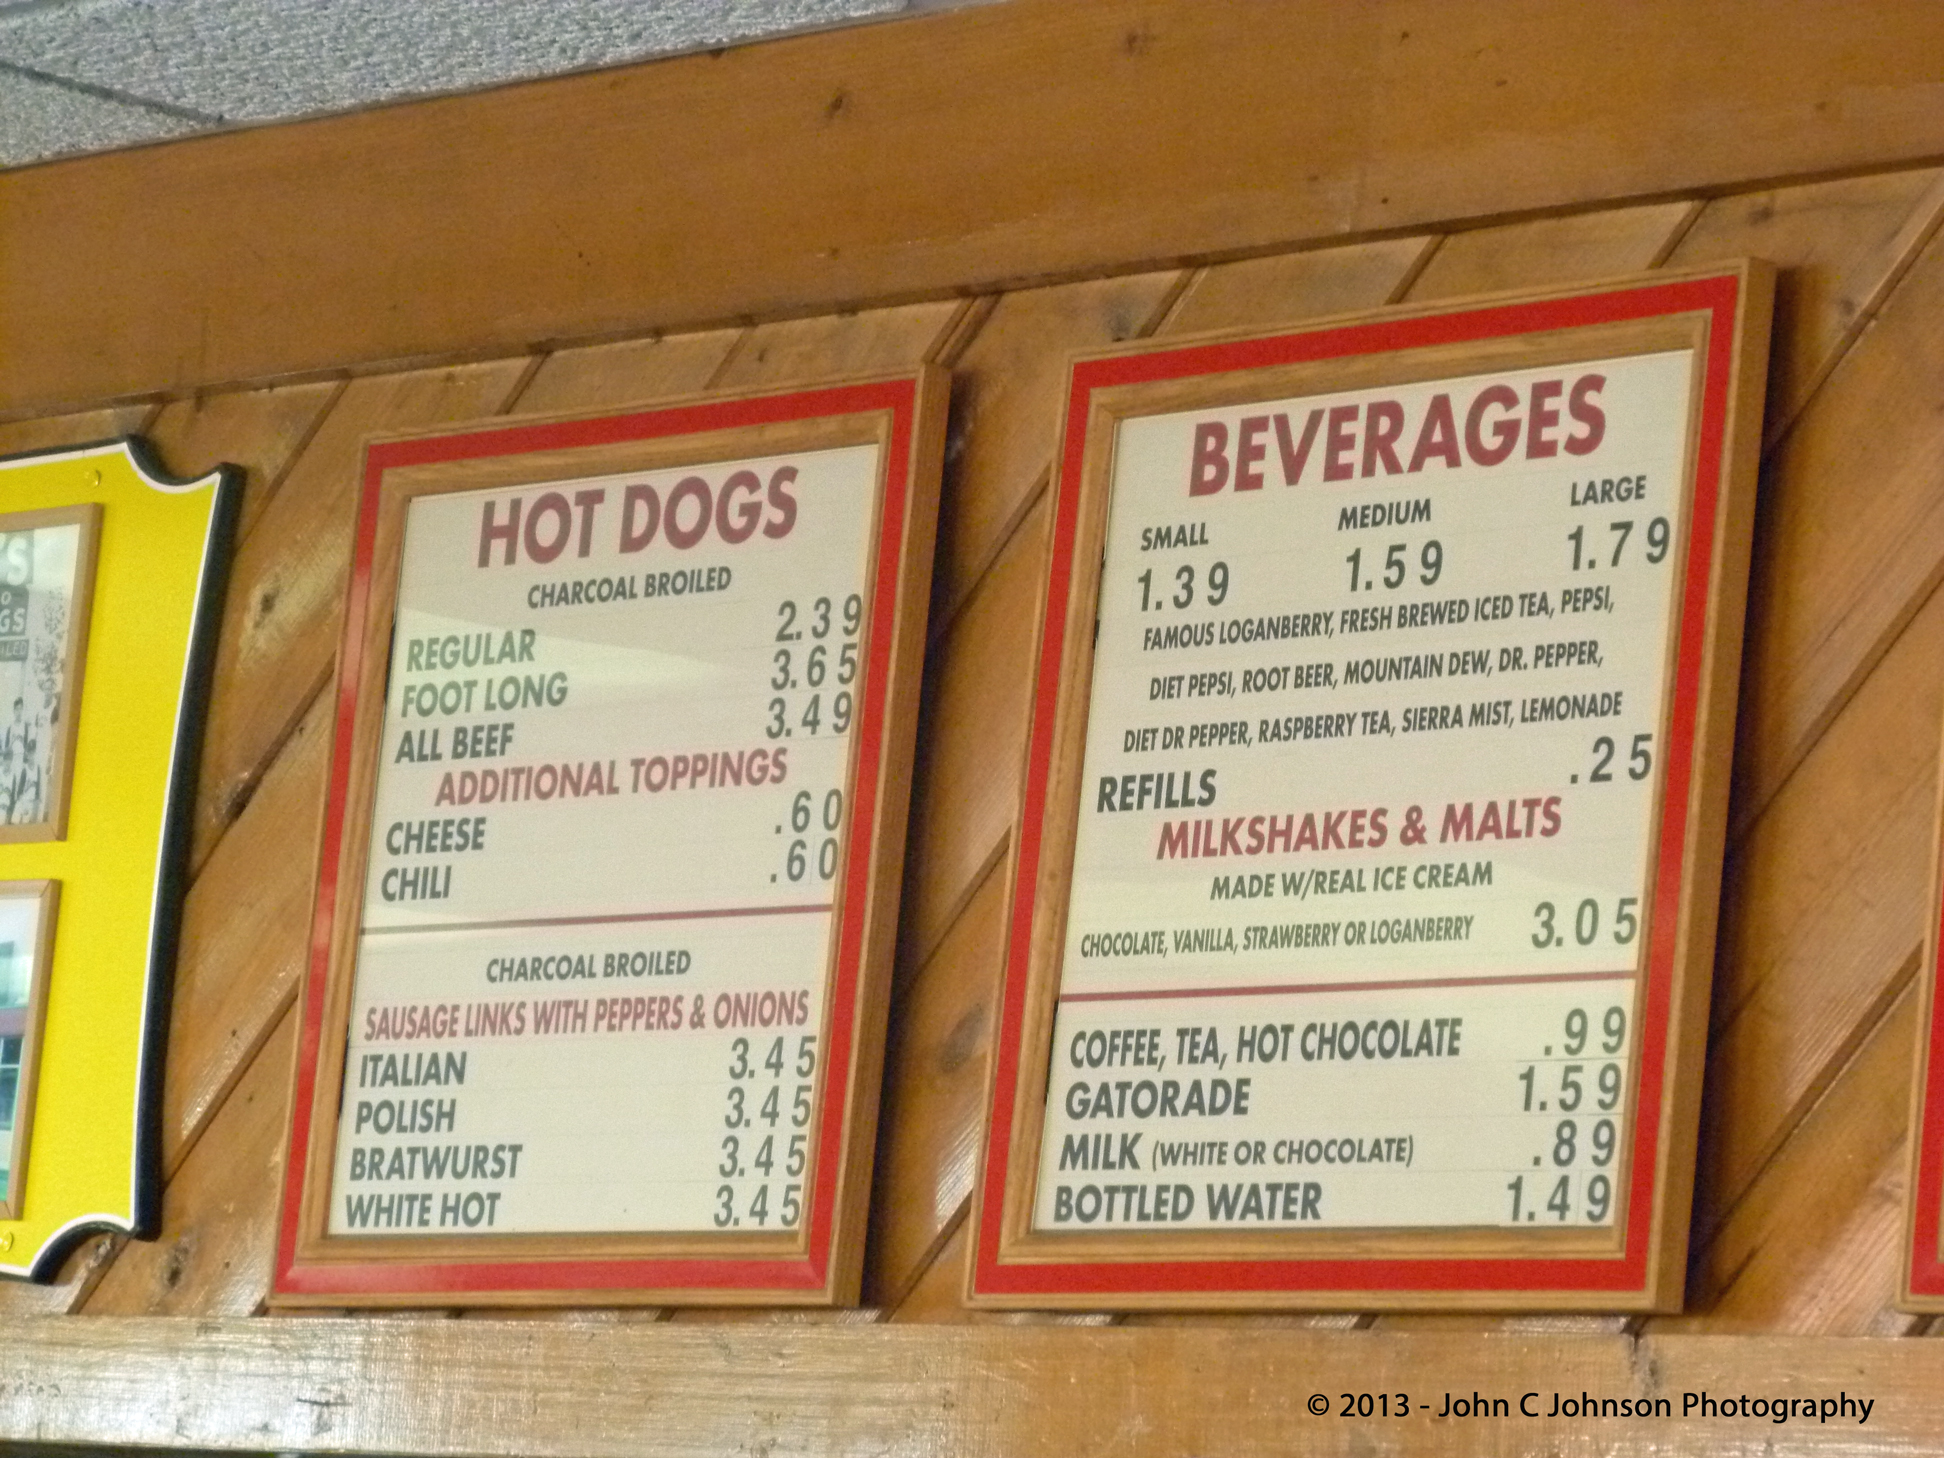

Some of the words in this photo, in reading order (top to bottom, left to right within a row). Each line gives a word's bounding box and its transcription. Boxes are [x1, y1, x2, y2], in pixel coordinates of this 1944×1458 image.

[1189, 374, 1608, 497] BEVERAGES
[478, 489, 605, 568] HOT
[619, 466, 798, 553] DOGS
[1141, 523, 1208, 551] SMALL
[1338, 499, 1431, 531] MEDIUM
[1571, 475, 1646, 506] LARGE
[528, 576, 637, 609] CHARCOAL
[644, 566, 732, 597] BROILED
[1144, 622, 1214, 651] FAMOUS
[1219, 611, 1334, 644] LOGANBERRY,
[1340, 606, 1392, 633] FRESH
[1397, 599, 1469, 628] BREWED
[1474, 595, 1513, 621] ICED
[1519, 592, 1554, 618] TEA,
[1561, 586, 1613, 613] PEPSI,
[407, 629, 536, 672] REGULAR
[1150, 675, 1185, 700] DIET
[1188, 671, 1236, 698] PEPSI,
[1242, 666, 1290, 693] ROOT
[1294, 663, 1337, 689] BEER,
[1344, 654, 1443, 684] MOUNTAIN
[1448, 650, 1492, 676] DEW,
[1499, 647, 1527, 672] DR.
[1534, 640, 1603, 669] PEPPER,
[401, 680, 478, 718] FOOT
[485, 671, 568, 711] LONG
[395, 729, 442, 763] ALL
[452, 723, 514, 759] BEEF
[1124, 728, 1159, 752] DIET
[1162, 726, 1184, 750] DR
[1189, 721, 1252, 748] PEPPER,
[1259, 713, 1357, 742] RASPBERRY
[1361, 710, 1395, 737] TEA,
[1402, 705, 1463, 732] SIERRA
[1469, 700, 1514, 728] MIST,
[1521, 691, 1622, 723] LEMONADE
[435, 760, 619, 806] ADDITIONAL
[630, 747, 787, 793] TOPPINGS
[1097, 769, 1216, 813] REFILLS
[386, 817, 486, 855] CHEESE
[1157, 808, 1388, 860] MILKSHAKES
[1400, 805, 1427, 846] &
[1440, 796, 1561, 843] MALTS
[382, 865, 451, 902] CHILI
[1210, 874, 1275, 900] MADE
[1282, 868, 1366, 900] W/REAL
[1373, 866, 1407, 891] ICE
[1413, 861, 1492, 889] CREAM
[1081, 931, 1167, 958] CHOCOLATE,
[1174, 928, 1238, 954] VANILLA,
[1243, 922, 1341, 950] STRAWBERRY
[1344, 921, 1366, 946] OR
[1370, 916, 1474, 944] LOGANBERRY
[486, 954, 596, 983] CHARCOAL
[603, 950, 691, 978] BROILED
[364, 1004, 460, 1041] SAUSAGE
[464, 1001, 526, 1037] LINKS
[534, 999, 588, 1034] WITH
[594, 995, 684, 1032] PEPPERS
[689, 994, 705, 1030] &
[714, 990, 809, 1029] ONIONS
[1070, 1029, 1166, 1072] COFFEE,
[1176, 1027, 1227, 1070] TEA,
[1237, 1024, 1294, 1063] HOT
[1301, 1018, 1462, 1061] CHOCOLATE
[360, 1051, 467, 1087] ITALIAN
[355, 1099, 456, 1134] POLISH
[1066, 1078, 1251, 1120] GATORADE
[350, 1144, 523, 1181] BRATWURST
[1059, 1133, 1142, 1170] MILK
[1152, 1141, 1228, 1171] (WHITE
[1234, 1141, 1266, 1165] OR
[1273, 1135, 1413, 1167] CHOCOLATE)
[346, 1193, 432, 1227] WHITE
[440, 1192, 501, 1227] HOT
[1054, 1184, 1194, 1223] BOTTLED
[1207, 1182, 1322, 1220] WATER
